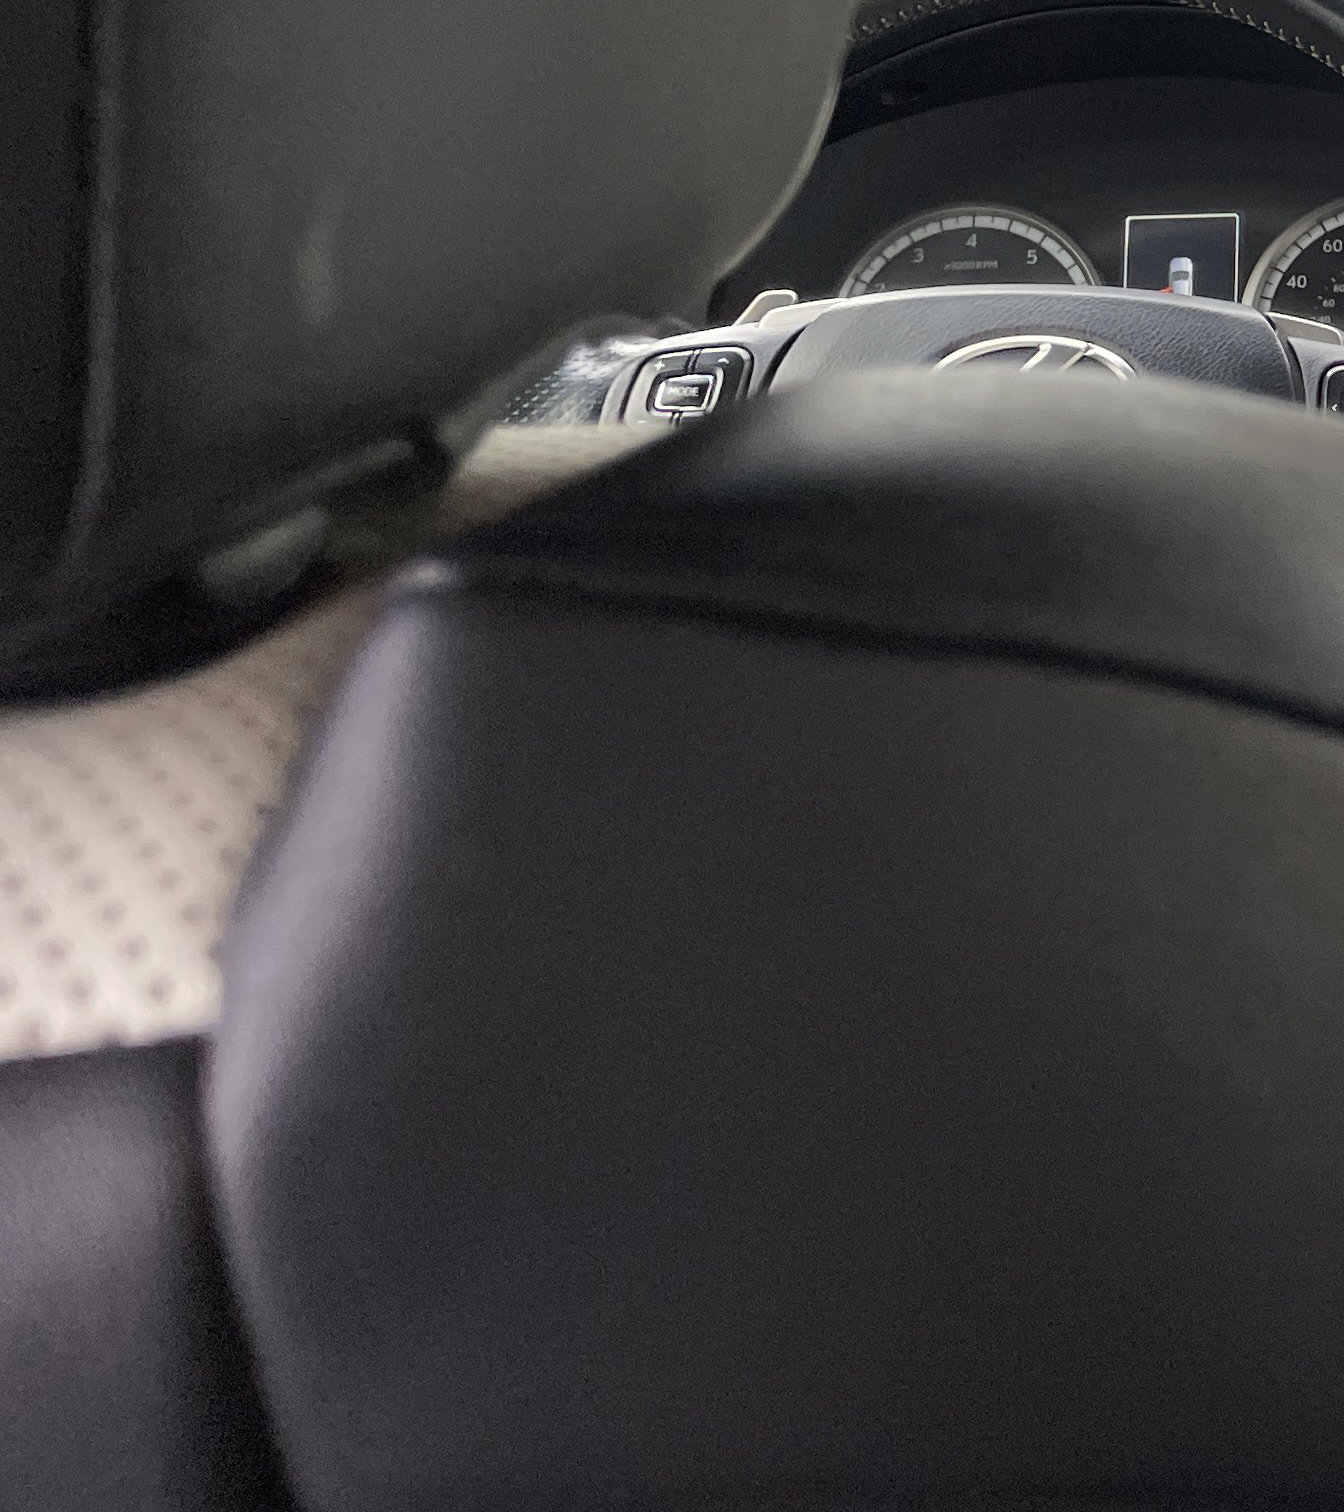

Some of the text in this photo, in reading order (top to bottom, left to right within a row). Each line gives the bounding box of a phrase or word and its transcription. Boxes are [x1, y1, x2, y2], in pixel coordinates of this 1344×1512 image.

[965, 232, 978, 248] 4
[1322, 239, 1343, 253] 60
[911, 247, 925, 264] 3
[1025, 249, 1038, 265] 5
[1286, 274, 1308, 289] 40
[1322, 298, 1336, 308] 60
